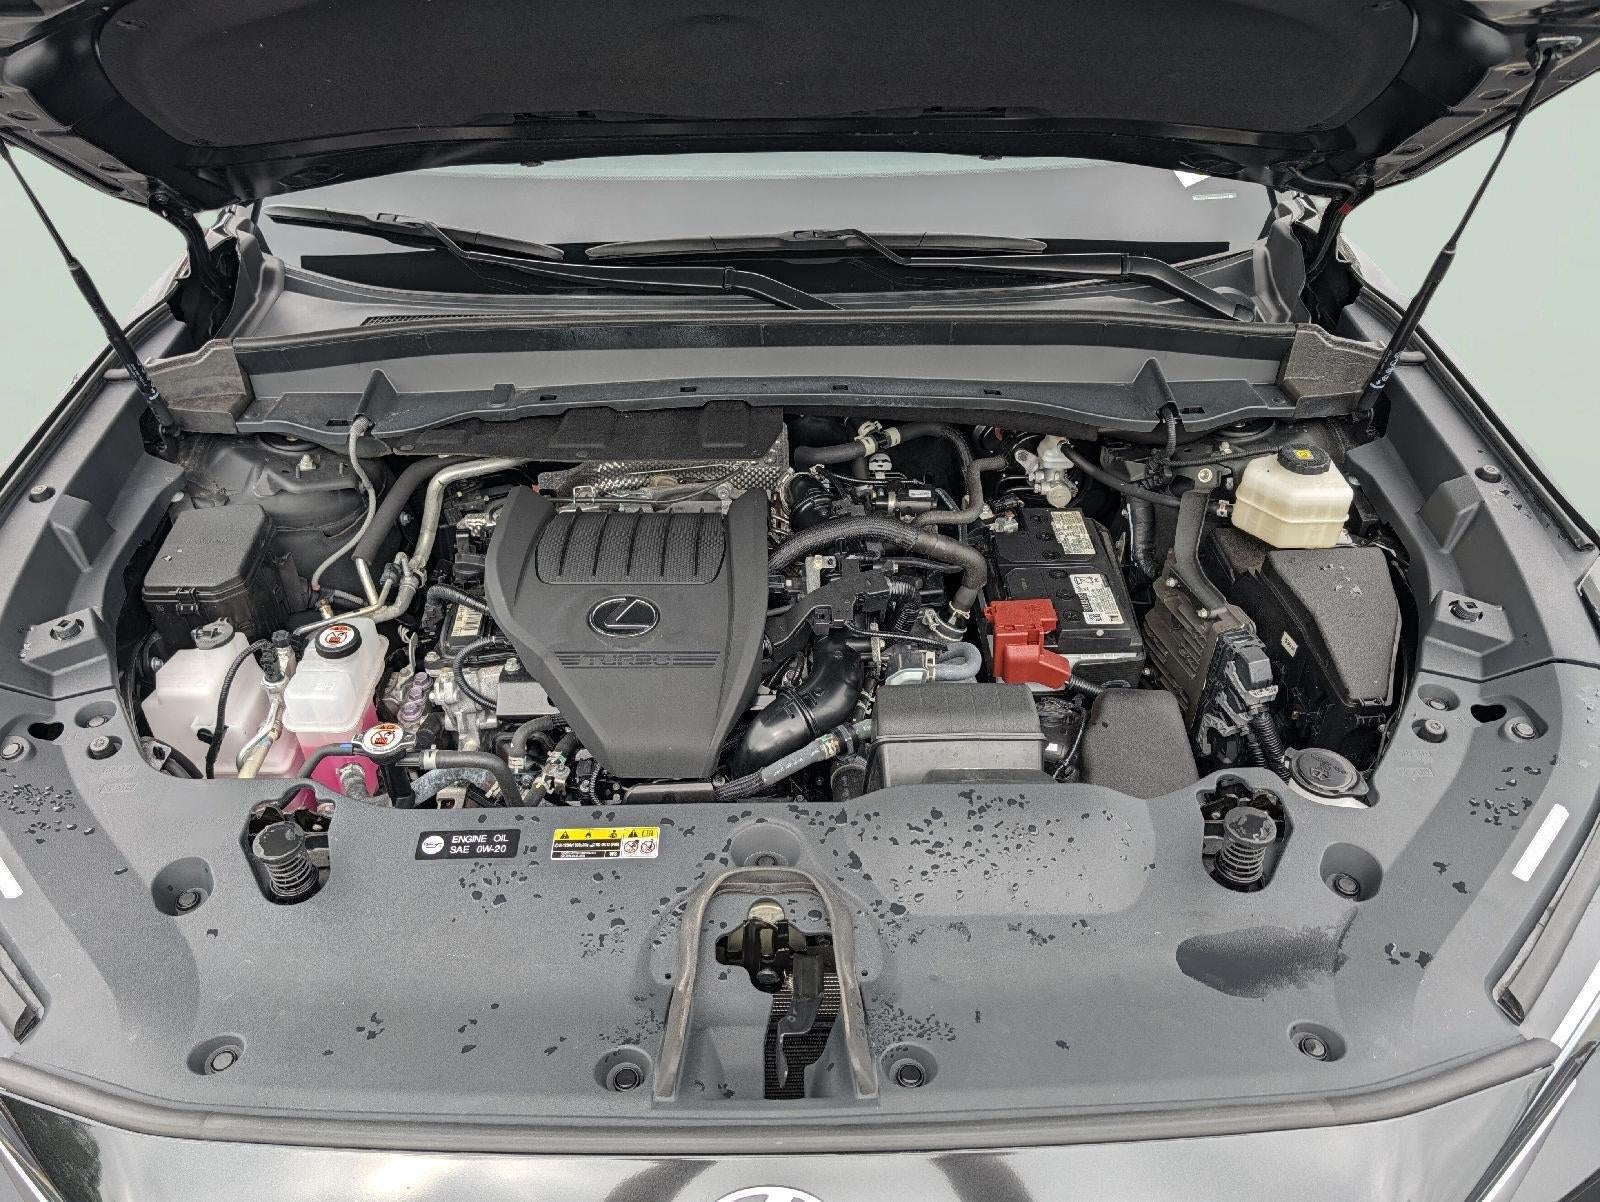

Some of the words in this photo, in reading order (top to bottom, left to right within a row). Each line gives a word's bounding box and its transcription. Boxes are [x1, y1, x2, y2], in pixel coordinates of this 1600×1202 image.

[451, 835, 487, 844] ENGINE
[493, 834, 509, 843] OIL
[449, 845, 470, 854] SAE
[476, 844, 507, 853] 0W-20
